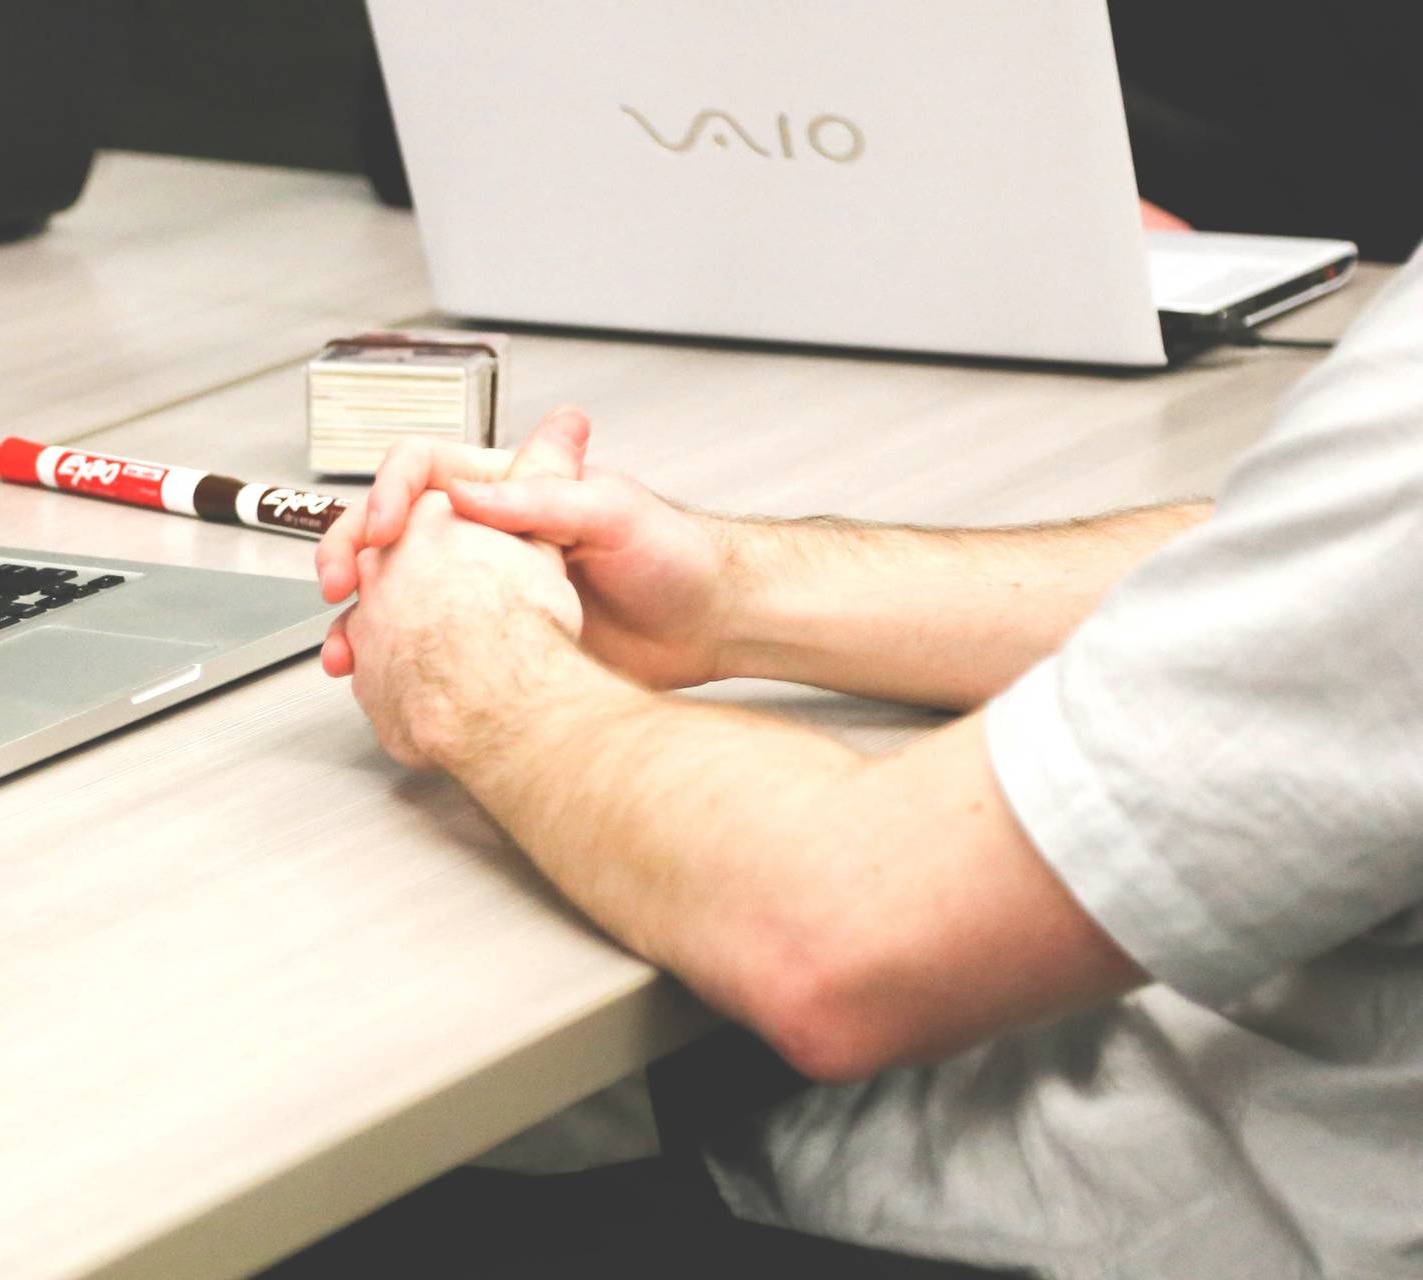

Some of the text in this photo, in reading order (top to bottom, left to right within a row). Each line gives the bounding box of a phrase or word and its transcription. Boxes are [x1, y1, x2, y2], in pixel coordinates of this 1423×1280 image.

[619, 102, 867, 163] VAIO
[58, 454, 122, 487] EXPO
[262, 487, 334, 518] EXPO
